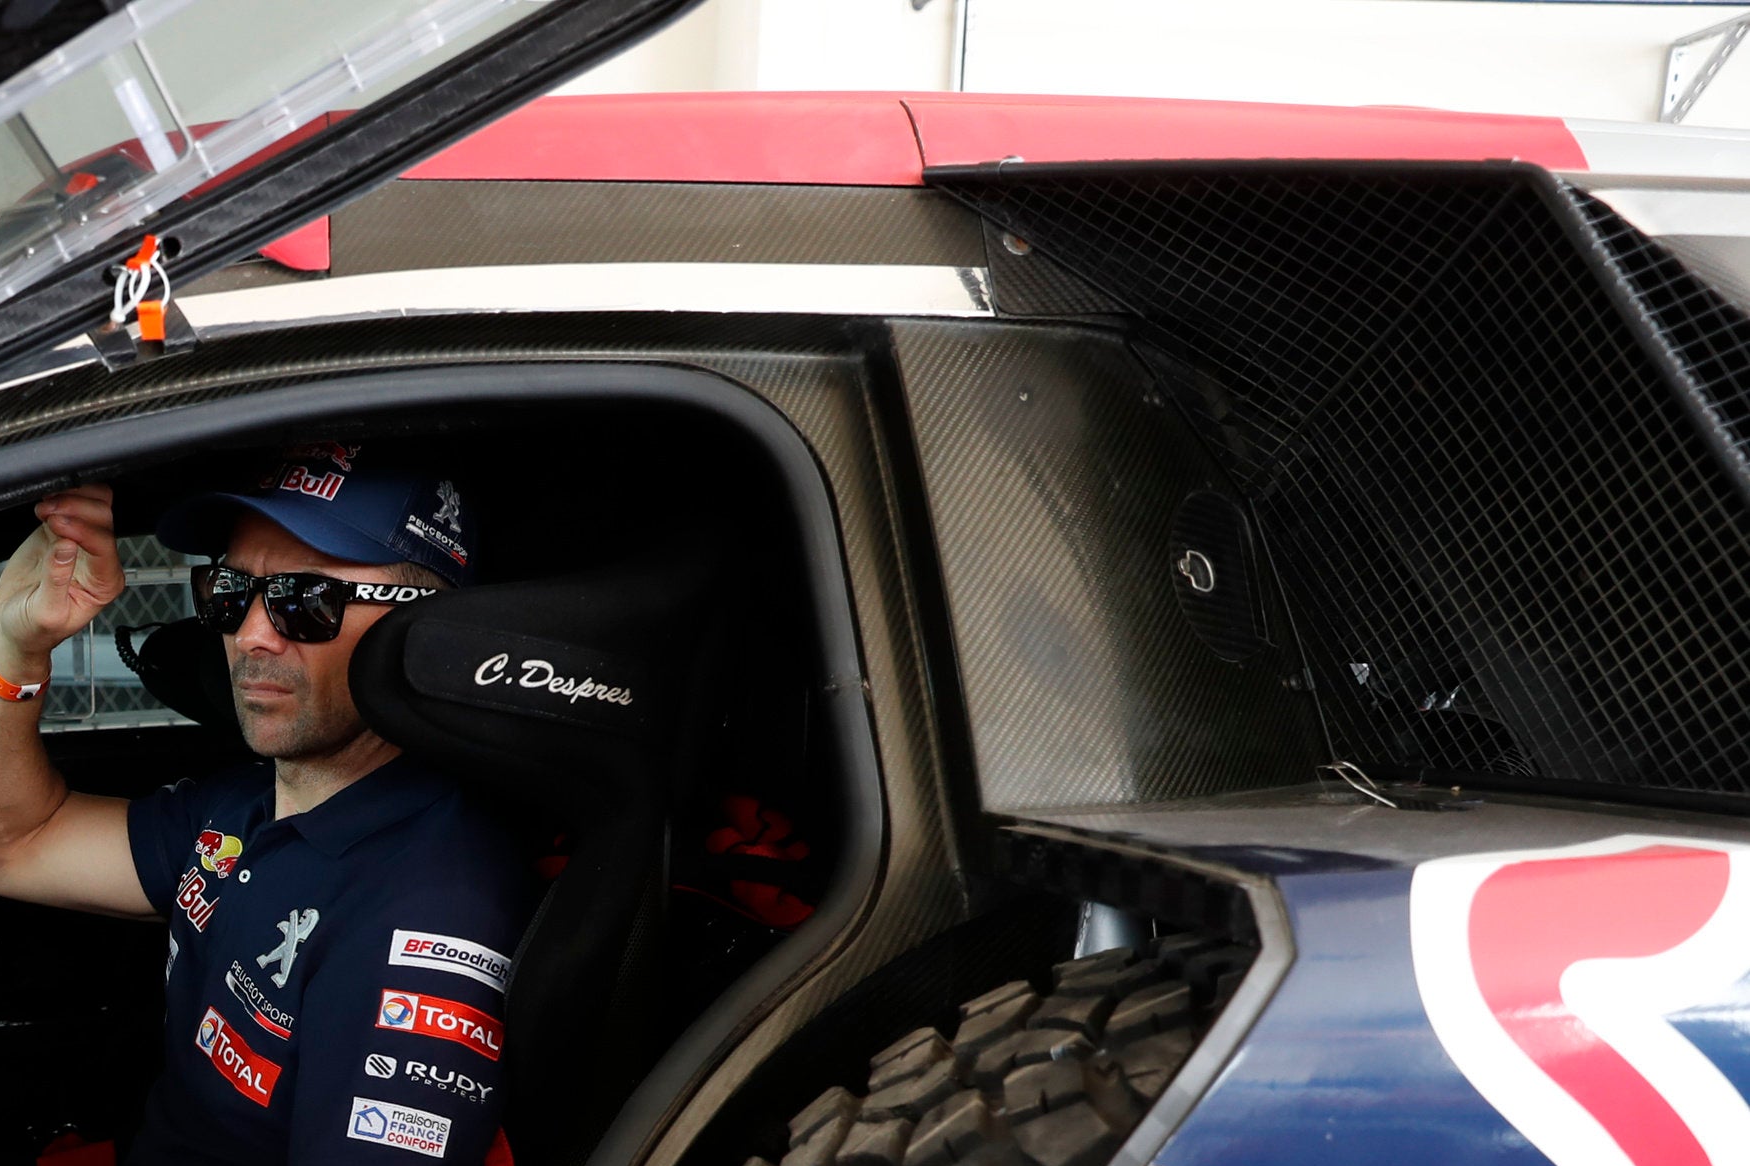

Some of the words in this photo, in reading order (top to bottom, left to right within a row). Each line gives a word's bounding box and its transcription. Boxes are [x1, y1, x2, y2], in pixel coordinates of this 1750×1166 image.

[280, 466, 345, 501] Bull
[408, 515, 454, 547] PEUGEOT
[403, 938, 509, 980] BFGoodrich
[231, 960, 264, 1005] PEUGEOT
[260, 1000, 294, 1029] SPORT
[420, 1005, 499, 1051] TOTAL
[217, 1032, 268, 1096] TOTAL
[405, 1060, 493, 1100] RUDY
[390, 1122, 445, 1143] FRANCE
[392, 1110, 448, 1133] maisons
[388, 1132, 443, 1153] CONFORT
